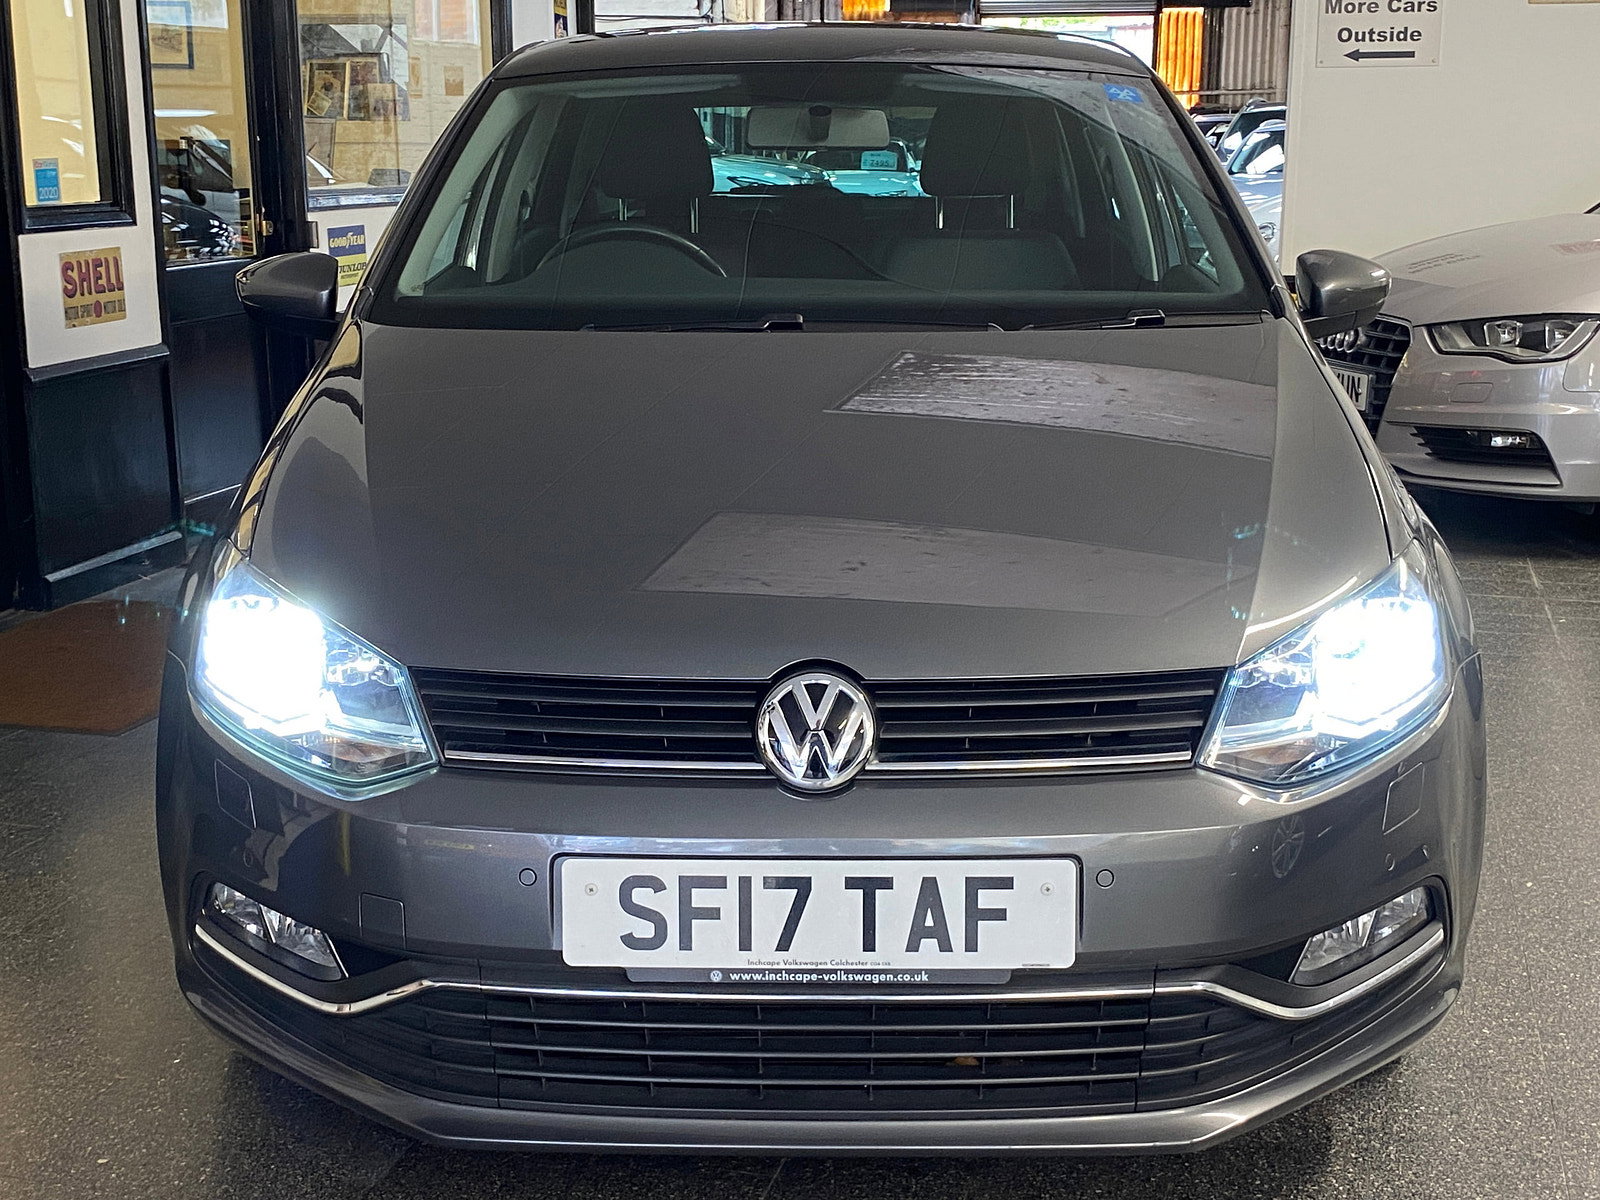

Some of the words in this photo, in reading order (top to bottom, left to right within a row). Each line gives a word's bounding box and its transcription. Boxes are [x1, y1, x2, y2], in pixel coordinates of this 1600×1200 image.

[1324, 0, 1379, 14] More
[1387, 0, 1438, 13] Cars
[1337, 26, 1422, 43] Outside
[39, 187, 59, 199] 2020
[62, 256, 124, 298] SHELL
[618, 874, 813, 952] SF17
[844, 876, 1015, 953] TAF
[747, 959, 781, 968] Inchcape
[782, 958, 828, 967] Volkswagen
[829, 958, 869, 967] Colchester
[729, 969, 930, 984] www.inchcape-volkswagen.co.uk
